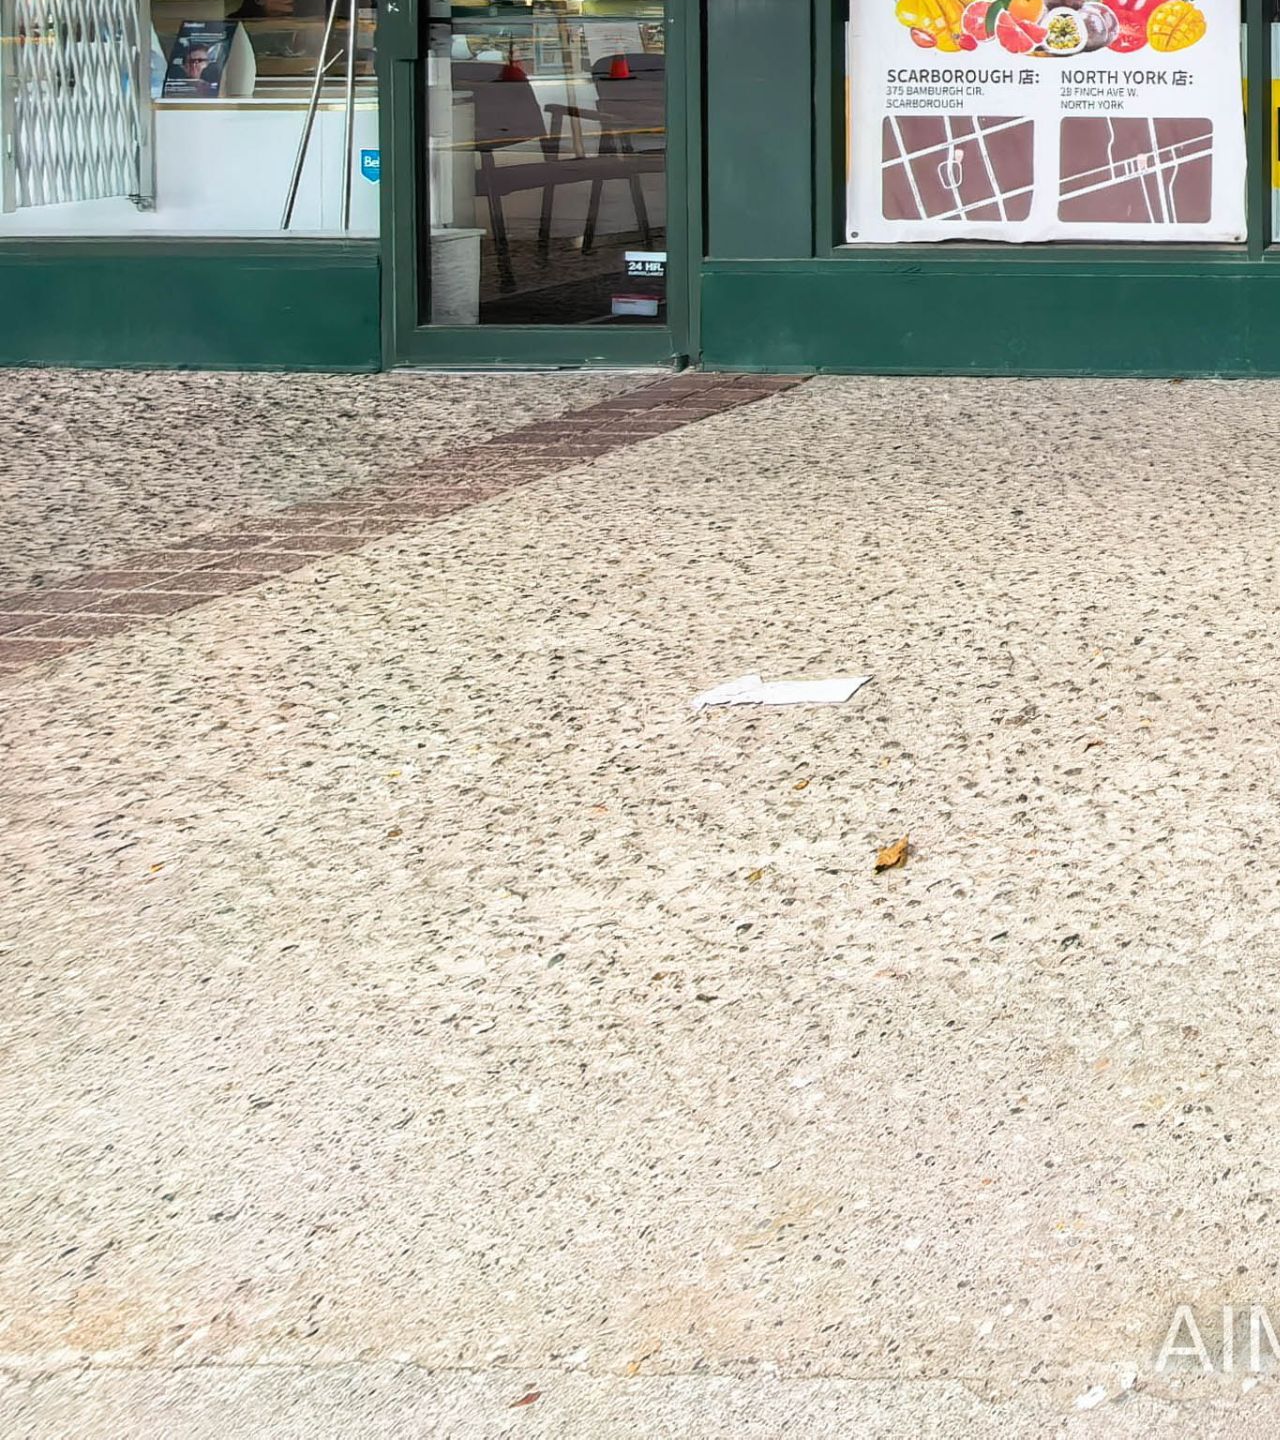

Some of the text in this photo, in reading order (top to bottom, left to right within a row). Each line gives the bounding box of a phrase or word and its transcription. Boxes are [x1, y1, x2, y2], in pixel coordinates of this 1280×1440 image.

[887, 69, 1013, 84] SCARBOROUGH
[1061, 70, 1118, 84] NORTH
[1123, 70, 1168, 85] YORK
[886, 86, 904, 96] 375
[906, 86, 963, 96] BAMBURGH
[1074, 87, 1104, 97] FINCH
[1106, 87, 1124, 97] AVE
[886, 99, 963, 109] SCARBOROUGH
[1060, 100, 1124, 110] NORTH YORK
[628, 261, 643, 271] 24
